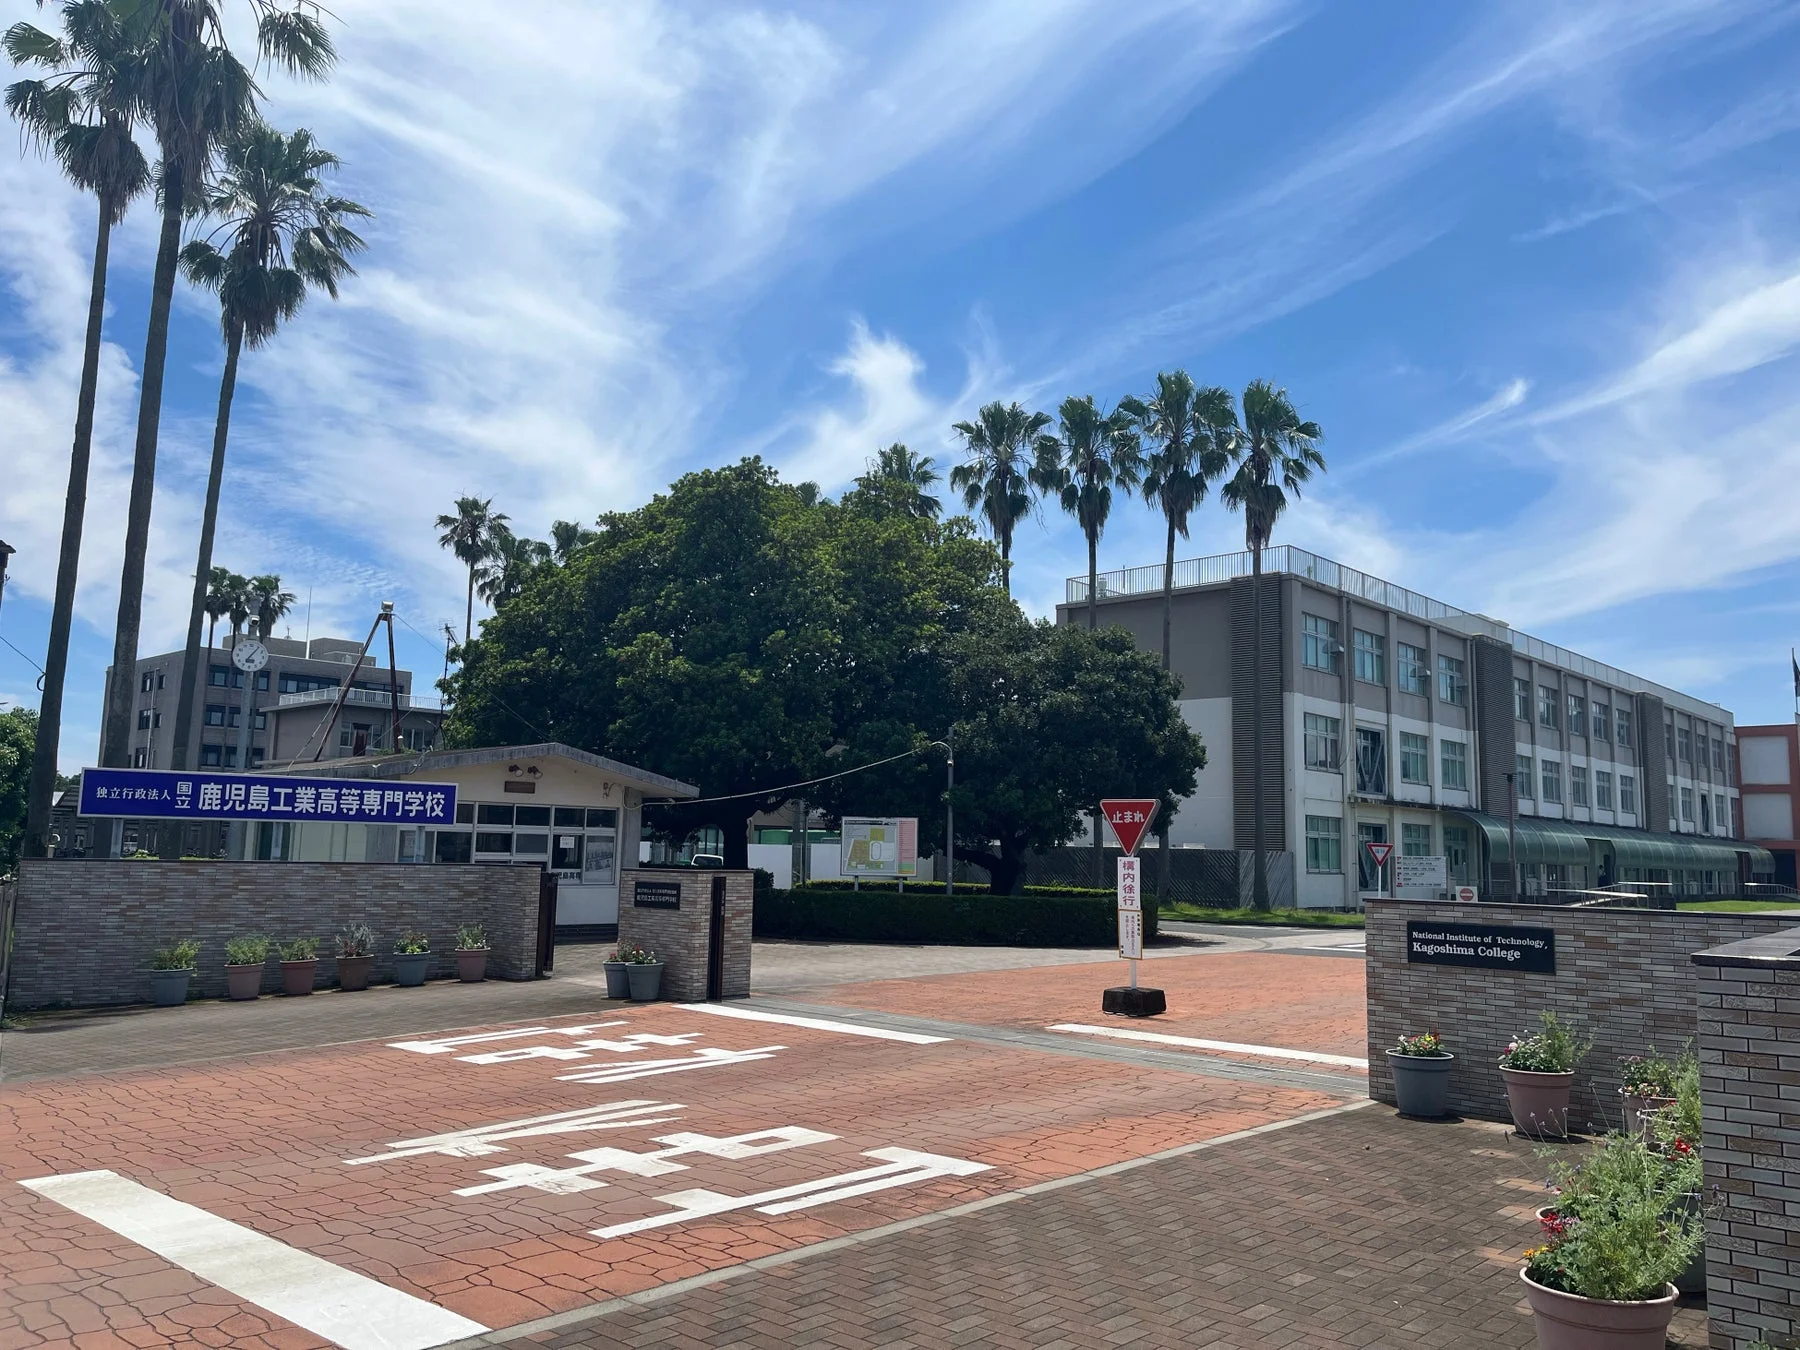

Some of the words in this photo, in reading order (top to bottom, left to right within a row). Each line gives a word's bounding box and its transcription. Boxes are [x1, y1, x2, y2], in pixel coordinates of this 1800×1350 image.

[96, 786, 171, 801] 独立行政法人
[175, 781, 192, 809] 国立
[198, 783, 445, 818] 鹿児島工業高等専門学校
[1112, 810, 1145, 823] 止まれ
[1122, 861, 1136, 906] 構内徐行
[1412, 931, 1444, 941] National
[1446, 933, 1482, 943] Institute
[1483, 935, 1492, 943] of
[1496, 936, 1548, 950] Technology,
[1412, 942, 1475, 955] Kagoshima
[1478, 946, 1521, 961] College
[386, 1021, 788, 1083] 止まれ
